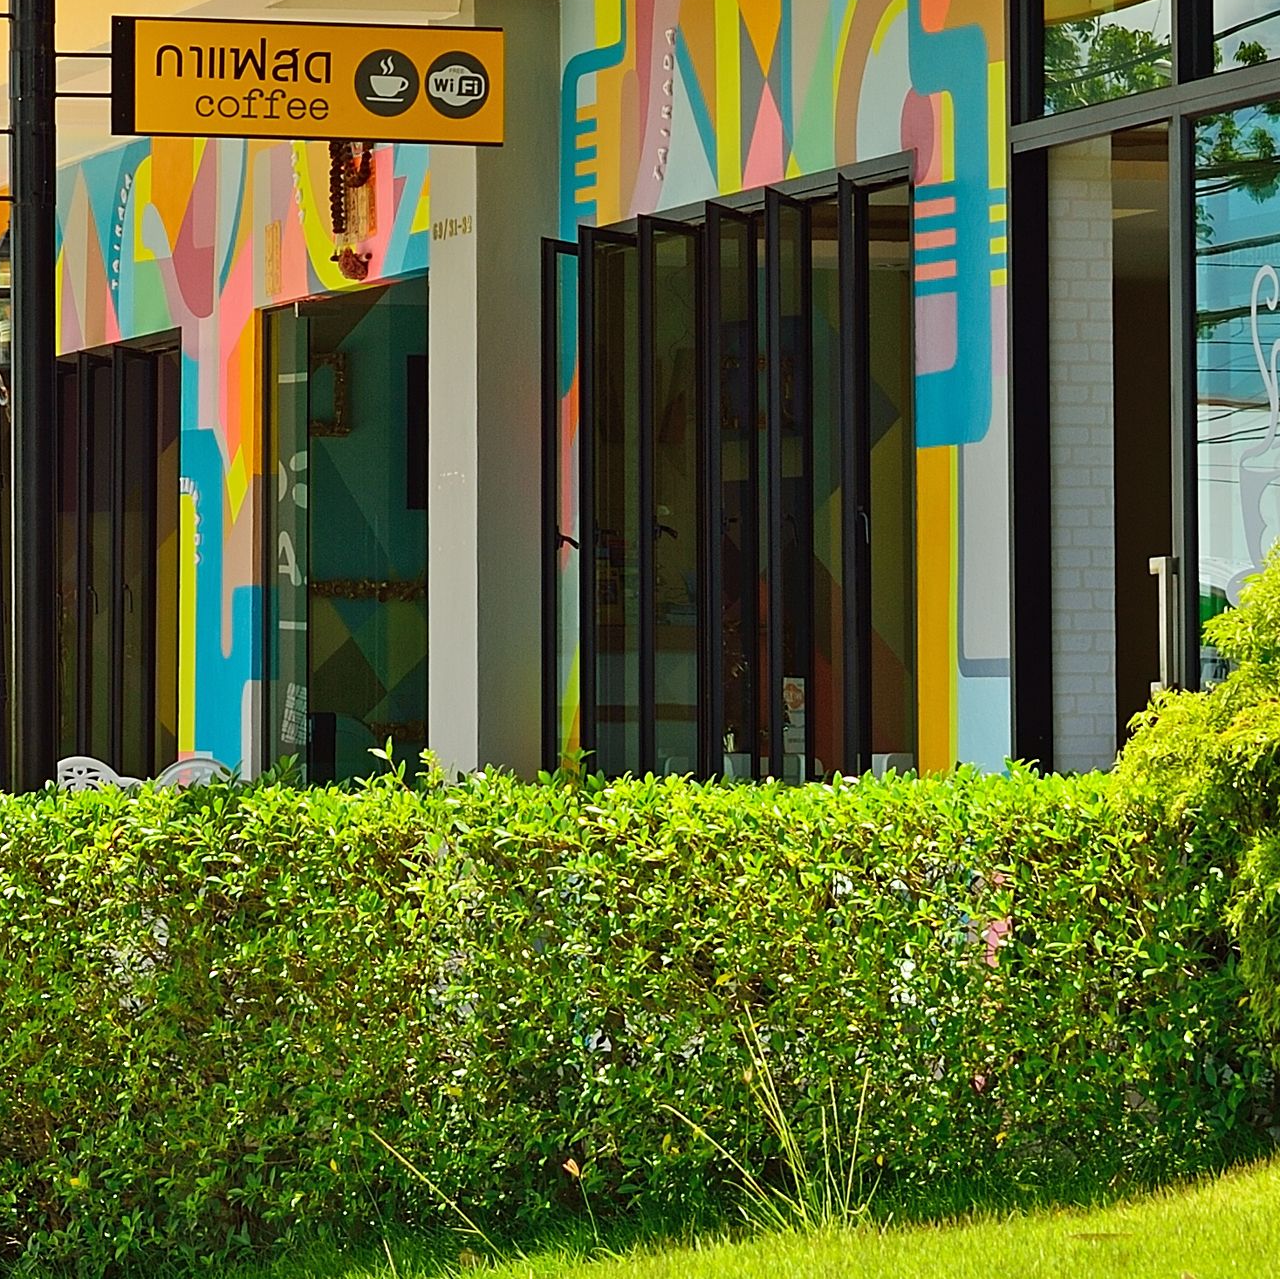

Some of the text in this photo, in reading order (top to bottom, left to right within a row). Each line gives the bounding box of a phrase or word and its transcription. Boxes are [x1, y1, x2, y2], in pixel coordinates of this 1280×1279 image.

[156, 37, 332, 84] กาแฟสด
[195, 88, 329, 121] coffee
